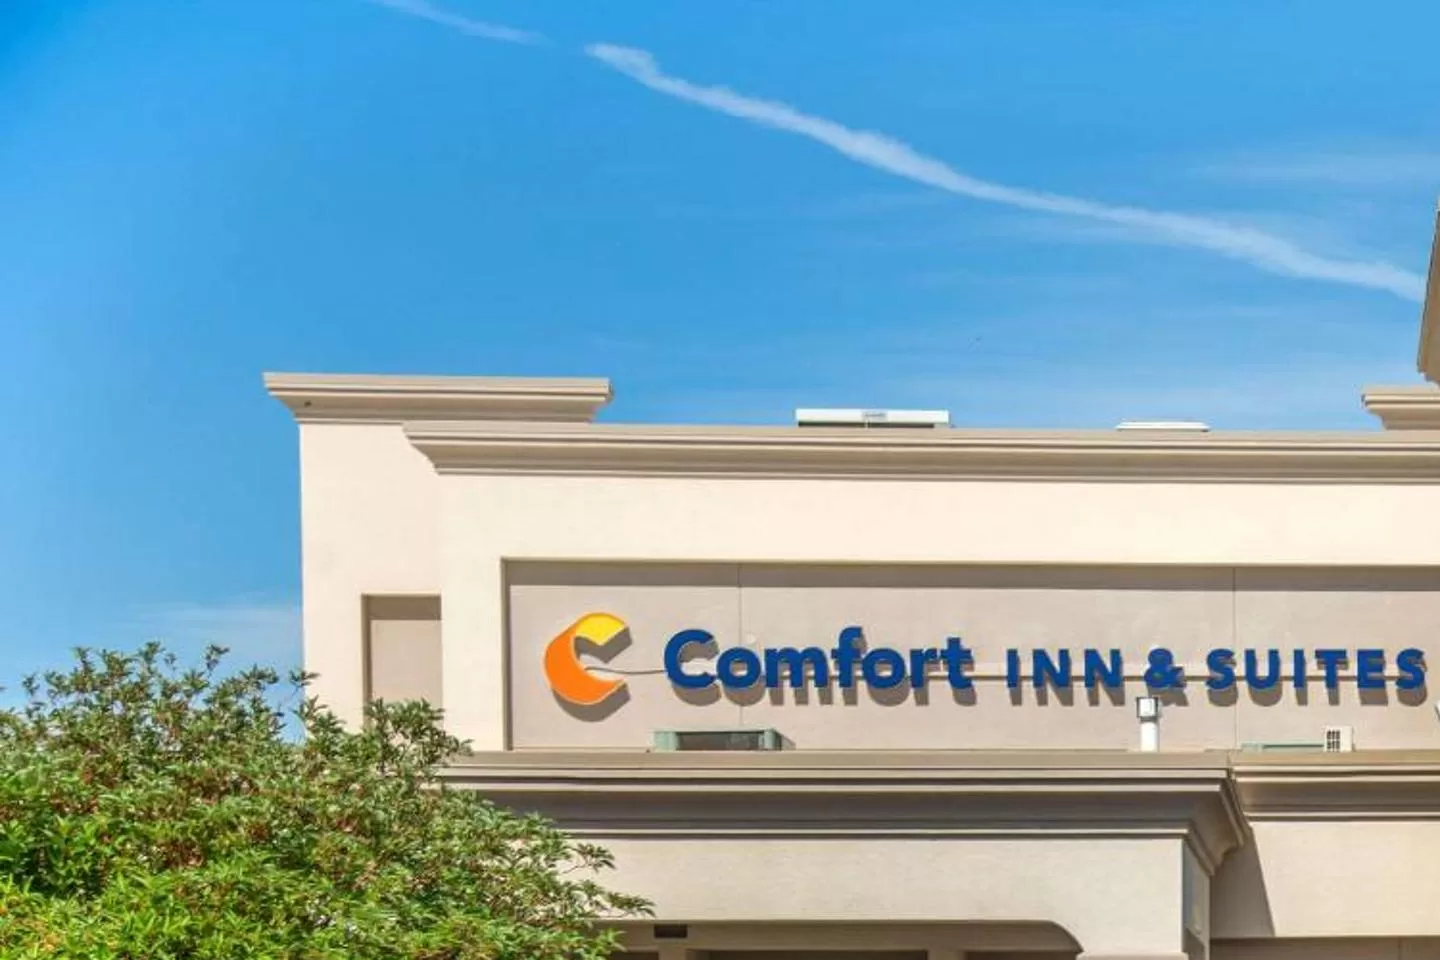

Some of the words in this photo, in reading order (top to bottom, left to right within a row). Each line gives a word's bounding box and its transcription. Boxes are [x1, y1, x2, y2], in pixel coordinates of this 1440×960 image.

[664, 627, 973, 690] Comfort
[1006, 649, 1124, 689] INN
[1143, 648, 1182, 689] &
[1206, 648, 1426, 690] SUITES
